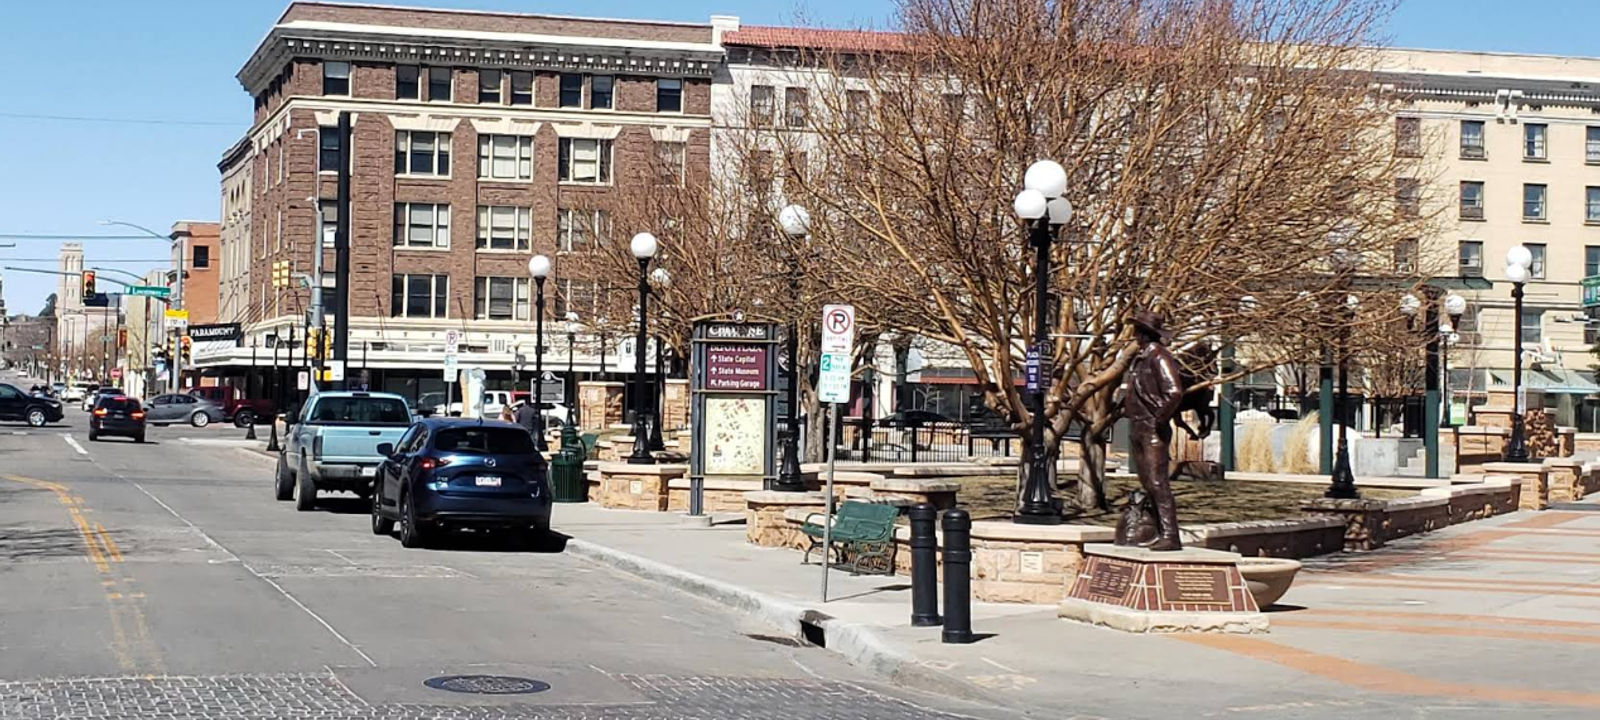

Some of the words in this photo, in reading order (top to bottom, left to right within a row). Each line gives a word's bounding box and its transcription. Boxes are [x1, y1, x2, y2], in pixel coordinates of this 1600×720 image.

[190, 327, 235, 337] PARAMOUNT
[708, 325, 764, 337] CHEYNE
[735, 355, 756, 364] Capitol
[718, 367, 734, 375] State
[735, 367, 759, 375] Museum
[718, 380, 739, 388] Parking
[740, 380, 760, 389] Garage
